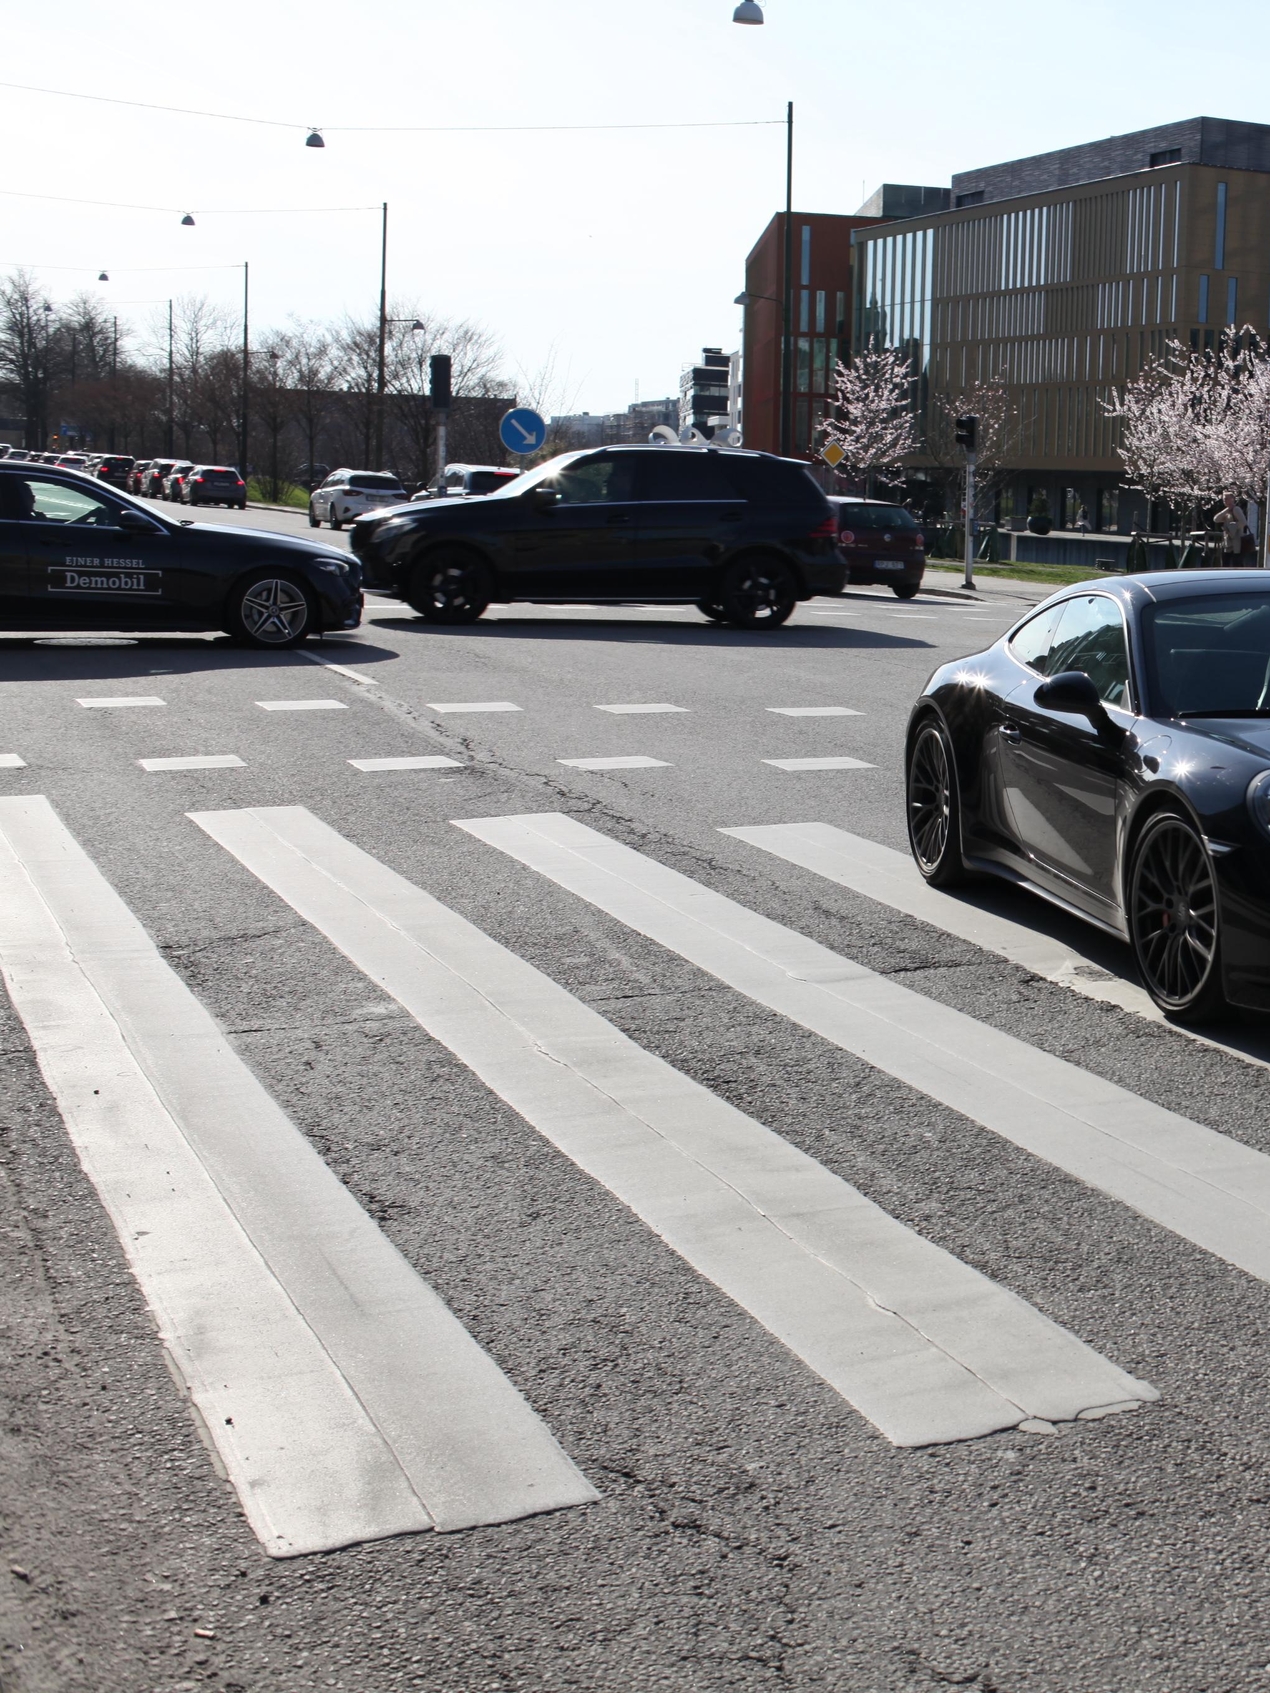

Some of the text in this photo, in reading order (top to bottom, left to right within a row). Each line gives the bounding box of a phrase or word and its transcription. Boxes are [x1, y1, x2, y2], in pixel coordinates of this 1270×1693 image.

[65, 556, 145, 568] EJNER HESSEL
[65, 571, 146, 590] Demobil
